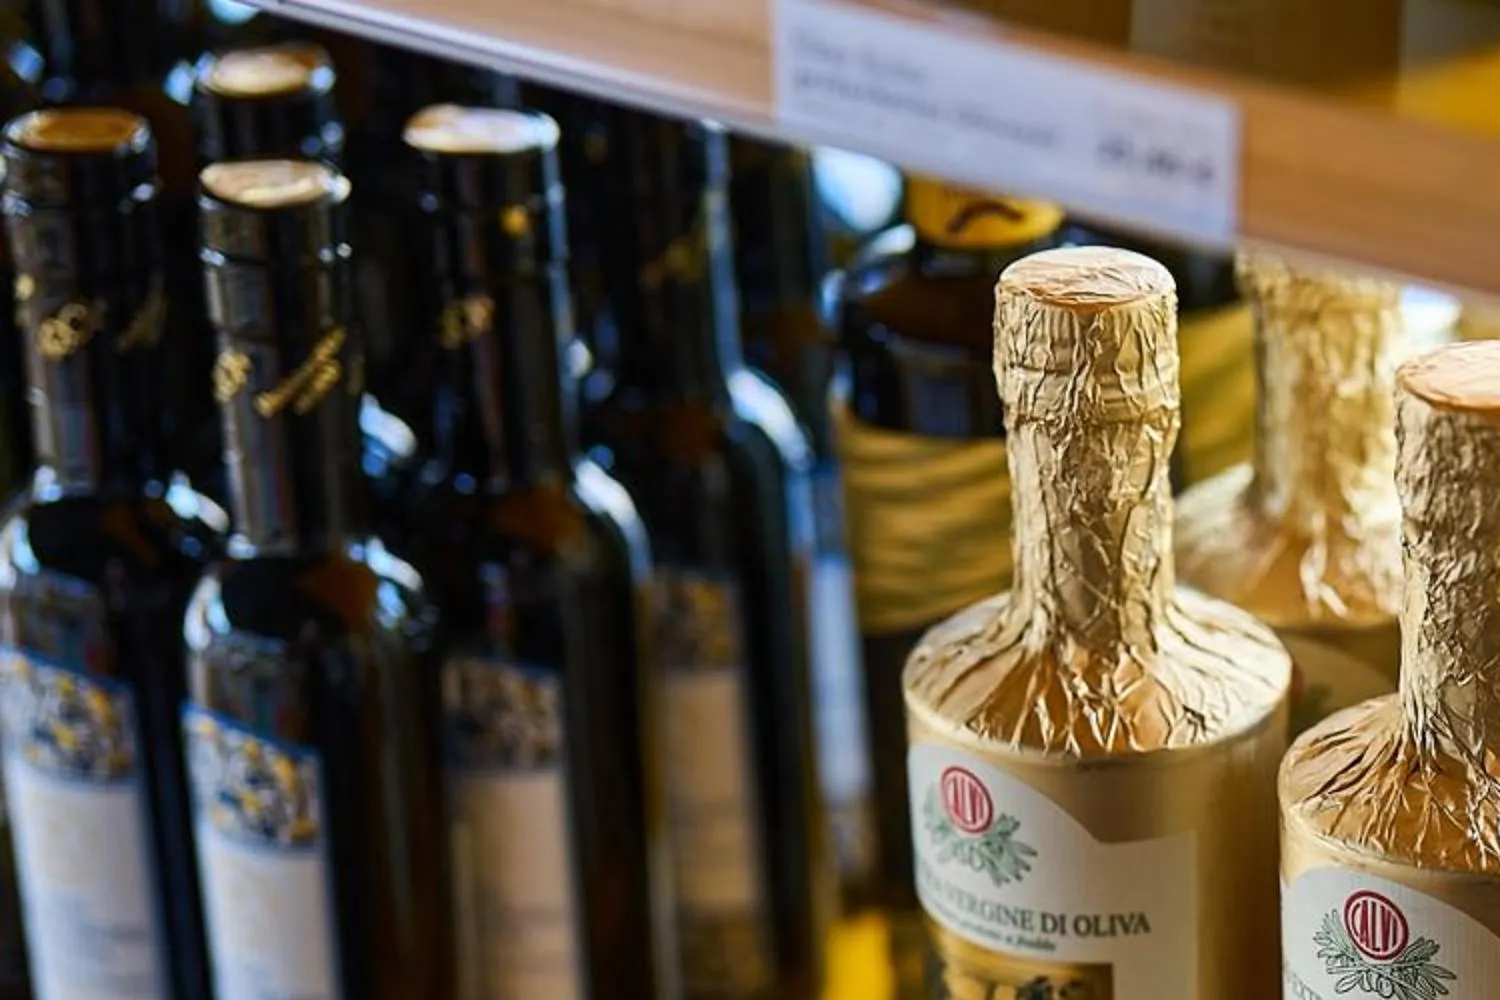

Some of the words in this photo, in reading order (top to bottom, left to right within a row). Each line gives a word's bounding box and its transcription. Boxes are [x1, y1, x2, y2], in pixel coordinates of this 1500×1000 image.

[1041, 913, 1067, 935] DI
[1073, 912, 1151, 938] OLIVA
[1351, 899, 1398, 952] CALVI
